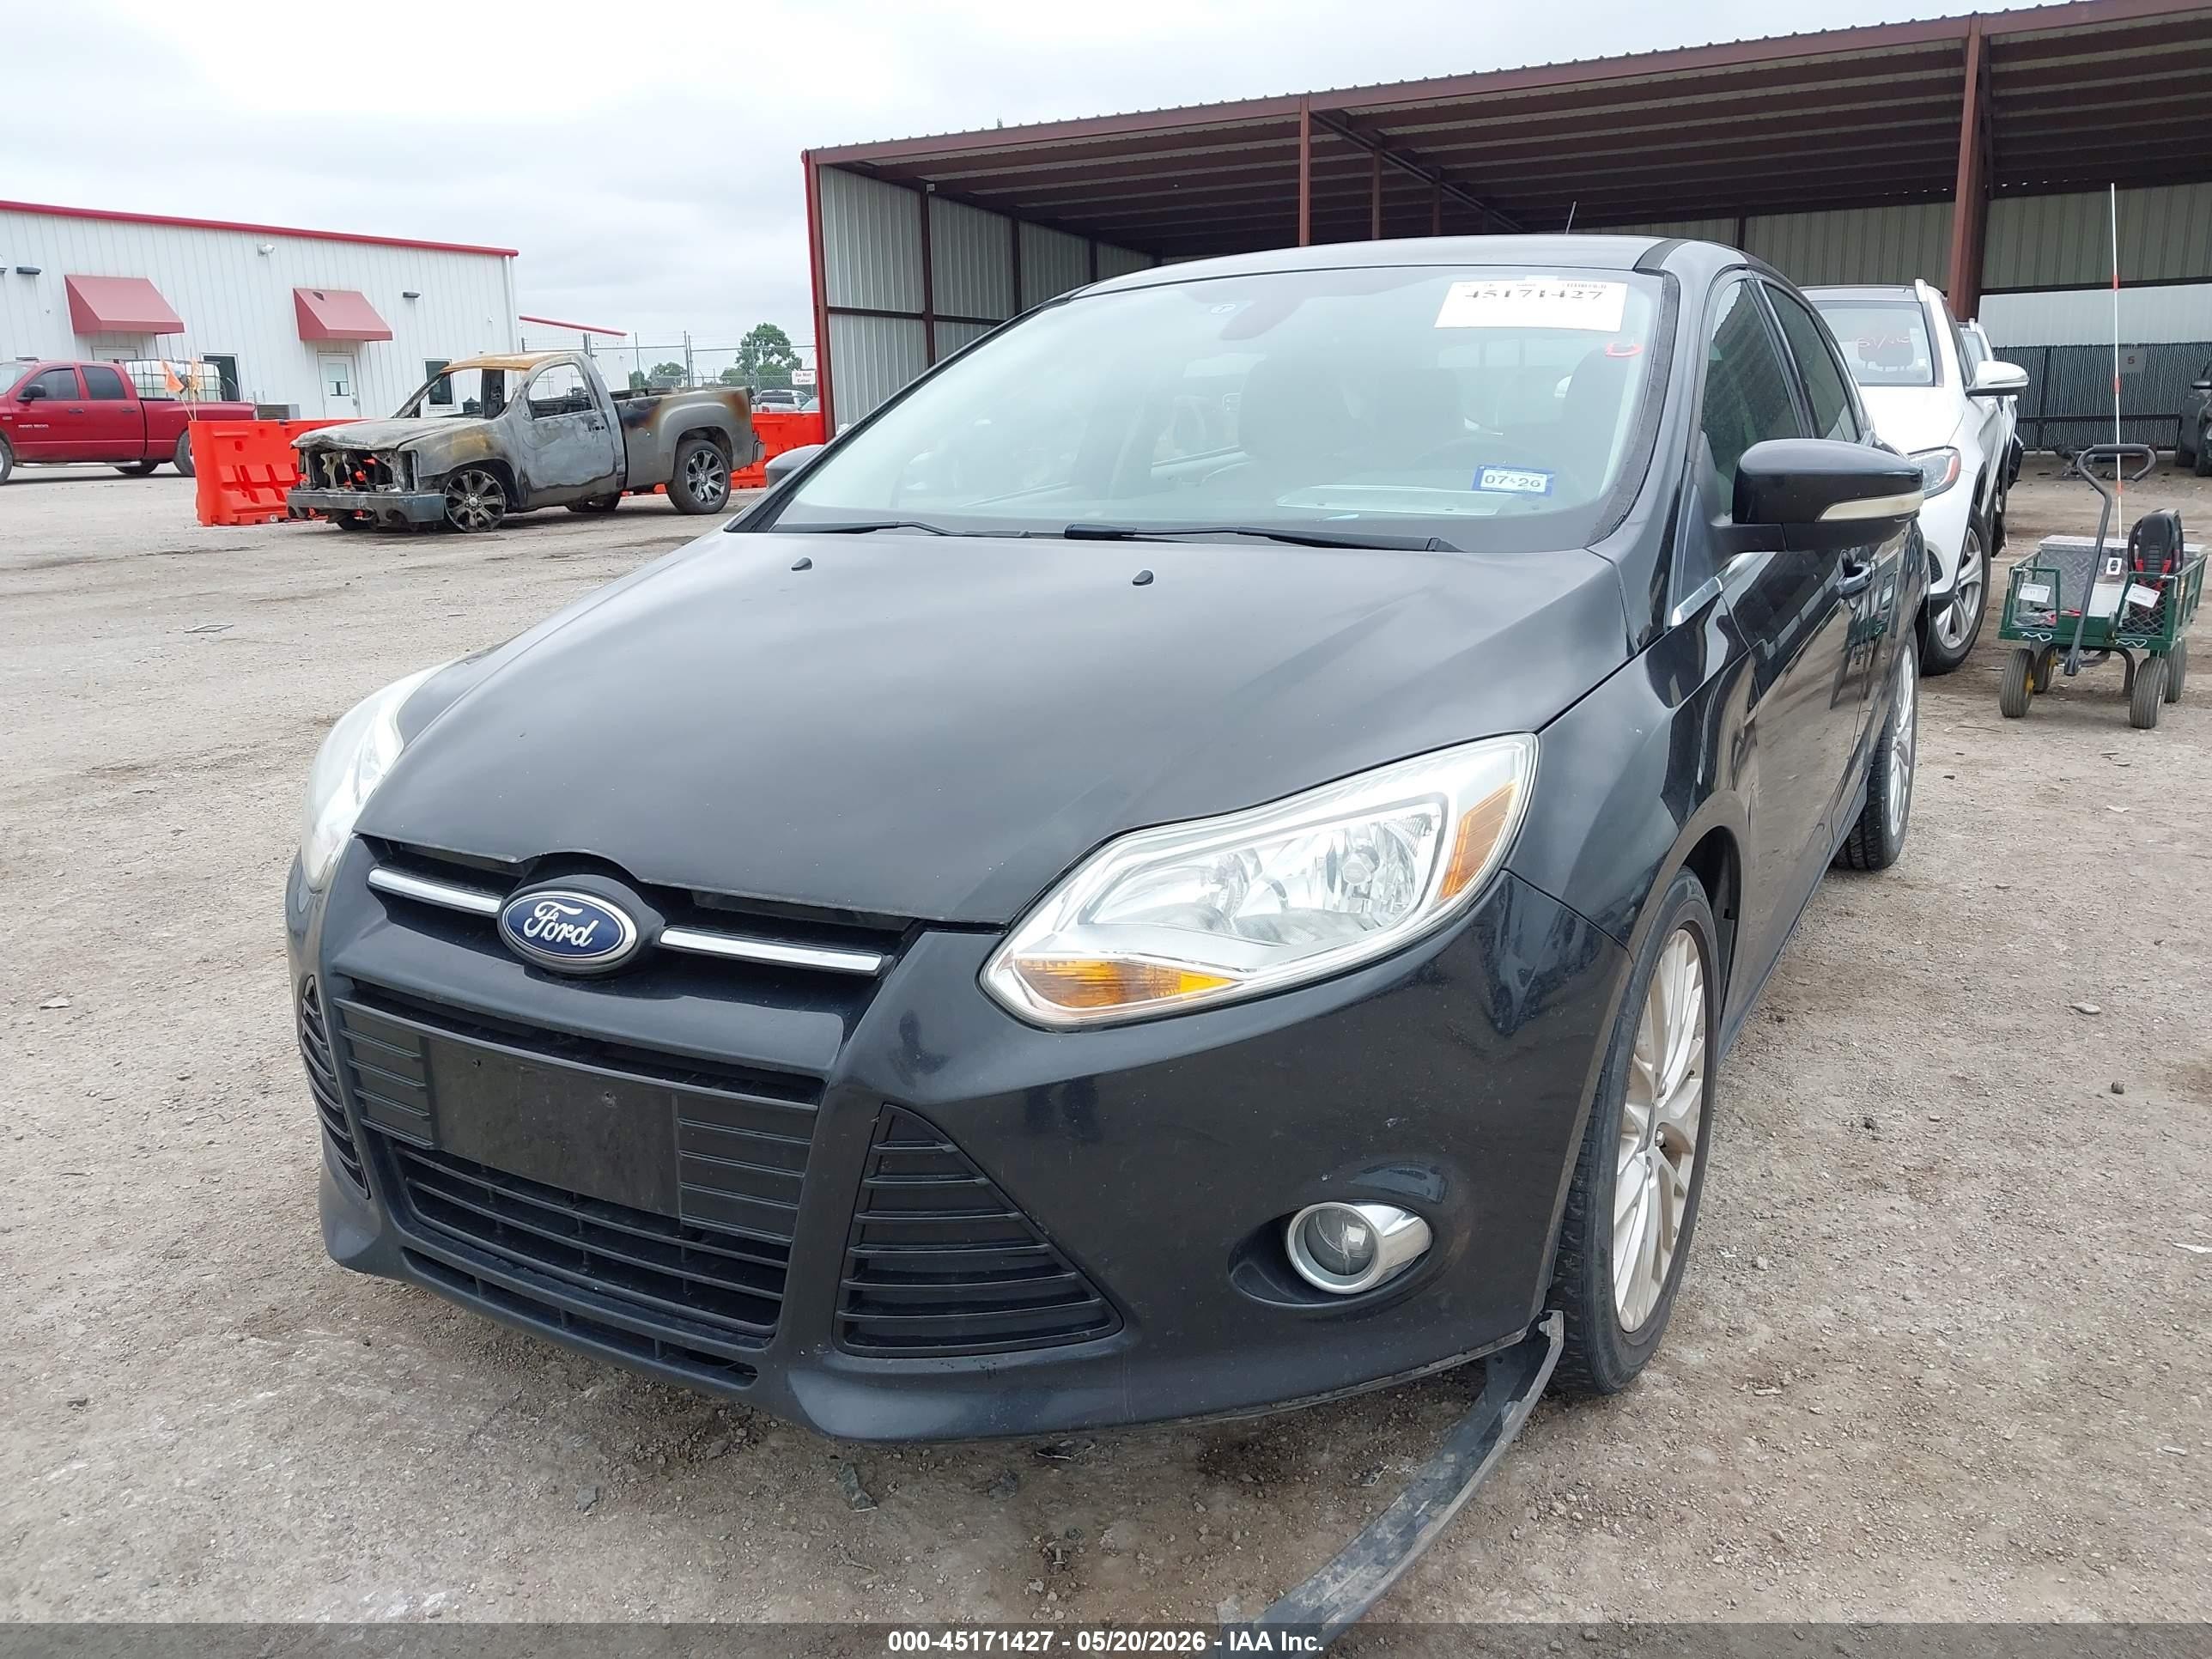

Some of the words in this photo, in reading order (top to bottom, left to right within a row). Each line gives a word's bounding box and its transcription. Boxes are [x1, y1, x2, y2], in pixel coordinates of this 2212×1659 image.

[2128, 356, 2136, 365] 5
[1485, 474, 1509, 485] 07
[523, 901, 599, 948] Ford
